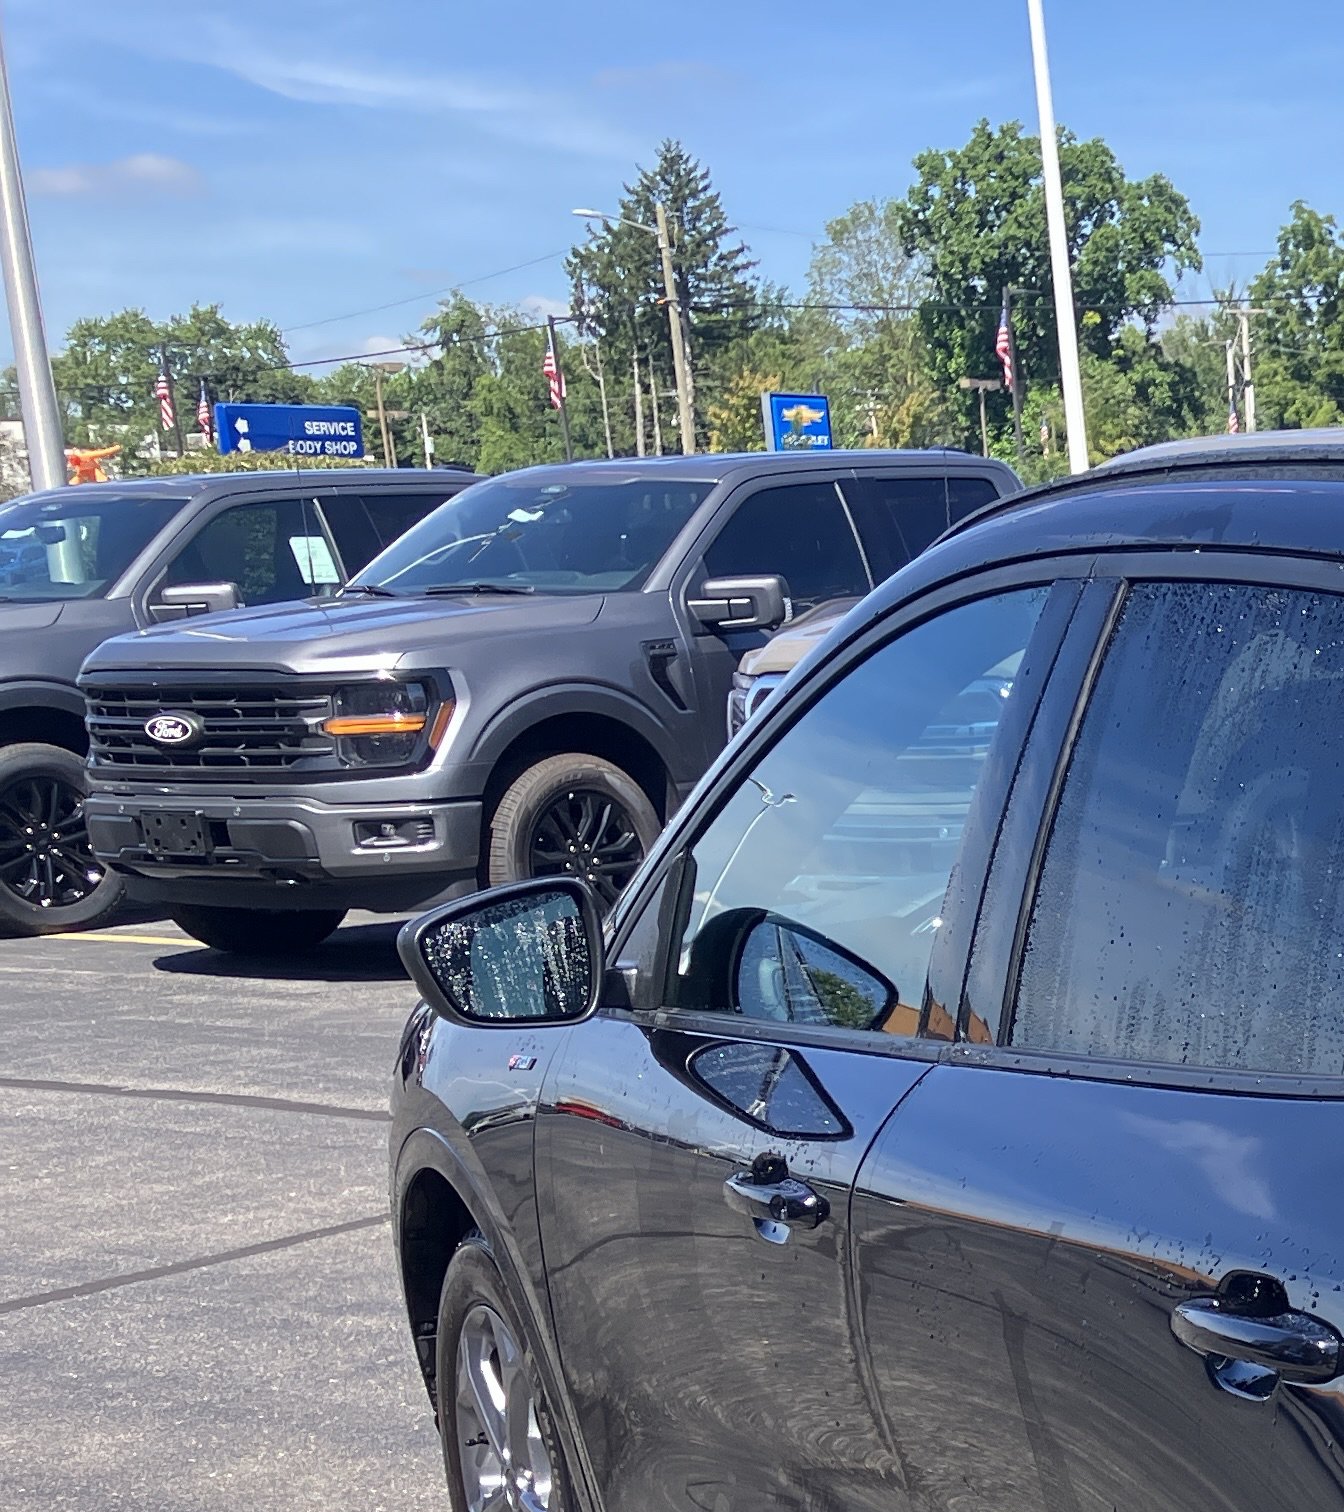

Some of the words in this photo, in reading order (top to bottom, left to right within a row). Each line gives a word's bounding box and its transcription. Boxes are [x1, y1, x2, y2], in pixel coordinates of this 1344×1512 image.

[303, 420, 356, 436] SERVICE
[288, 439, 322, 455] BODY
[324, 440, 358, 455] SHOP
[153, 719, 184, 739] Ford
